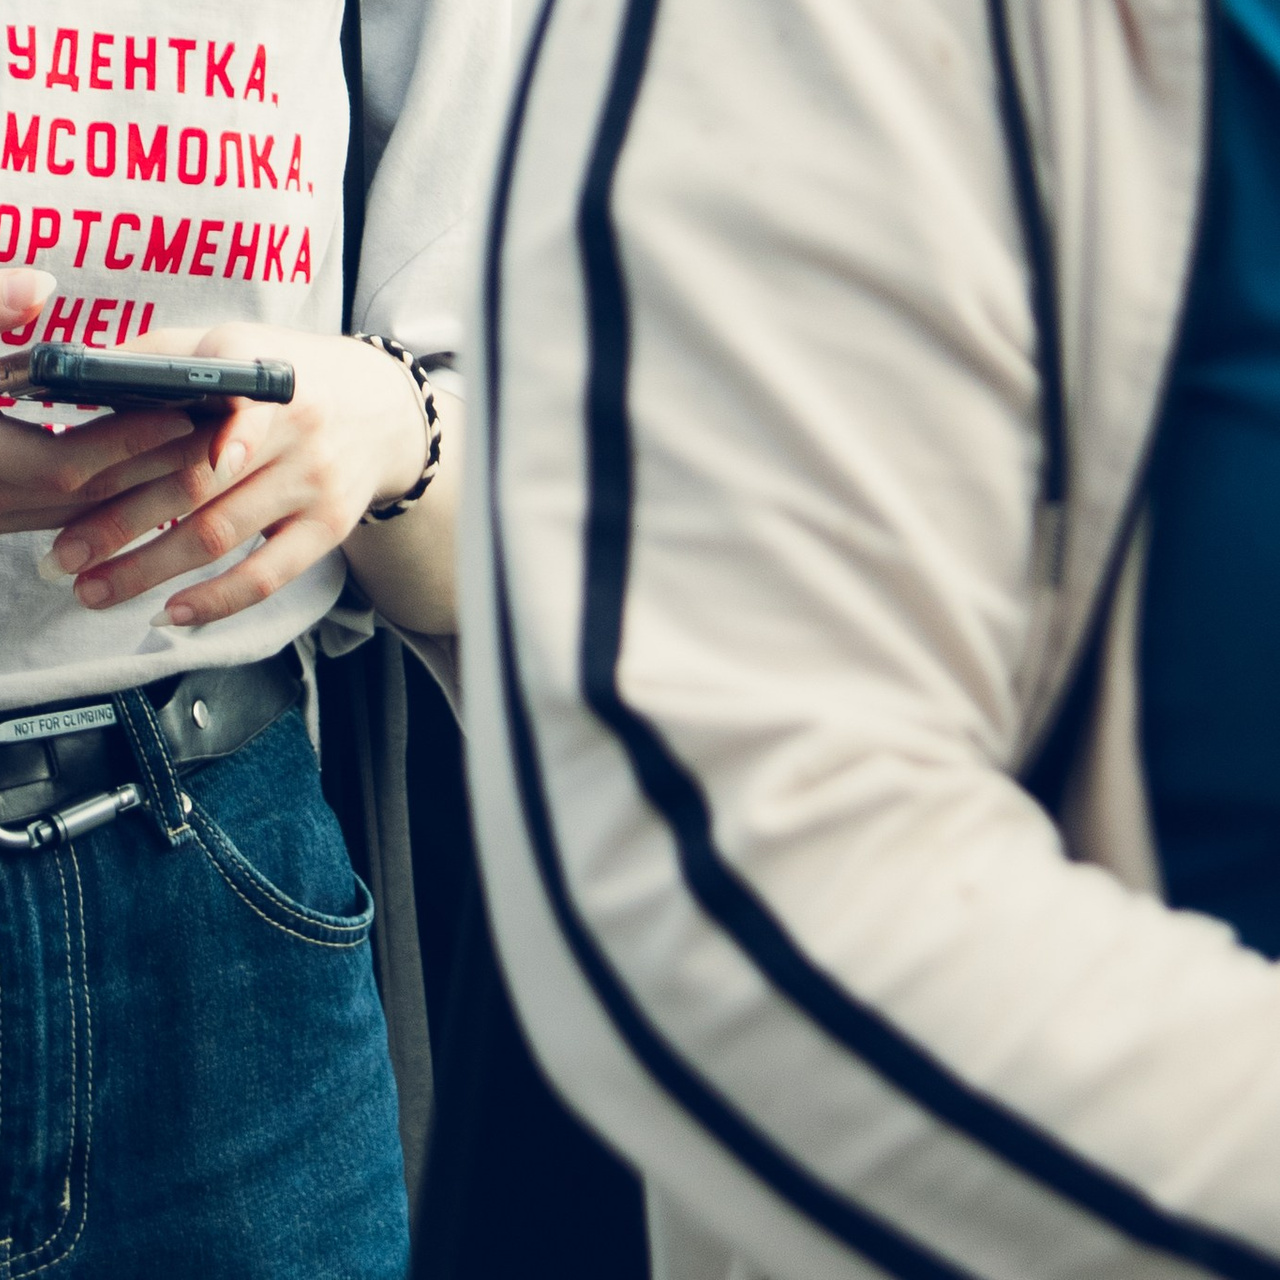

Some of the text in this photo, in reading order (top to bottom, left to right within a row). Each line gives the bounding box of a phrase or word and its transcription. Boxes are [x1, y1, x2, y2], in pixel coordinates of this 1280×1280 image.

[13, 707, 114, 736] NOT FOR CLIMBING
